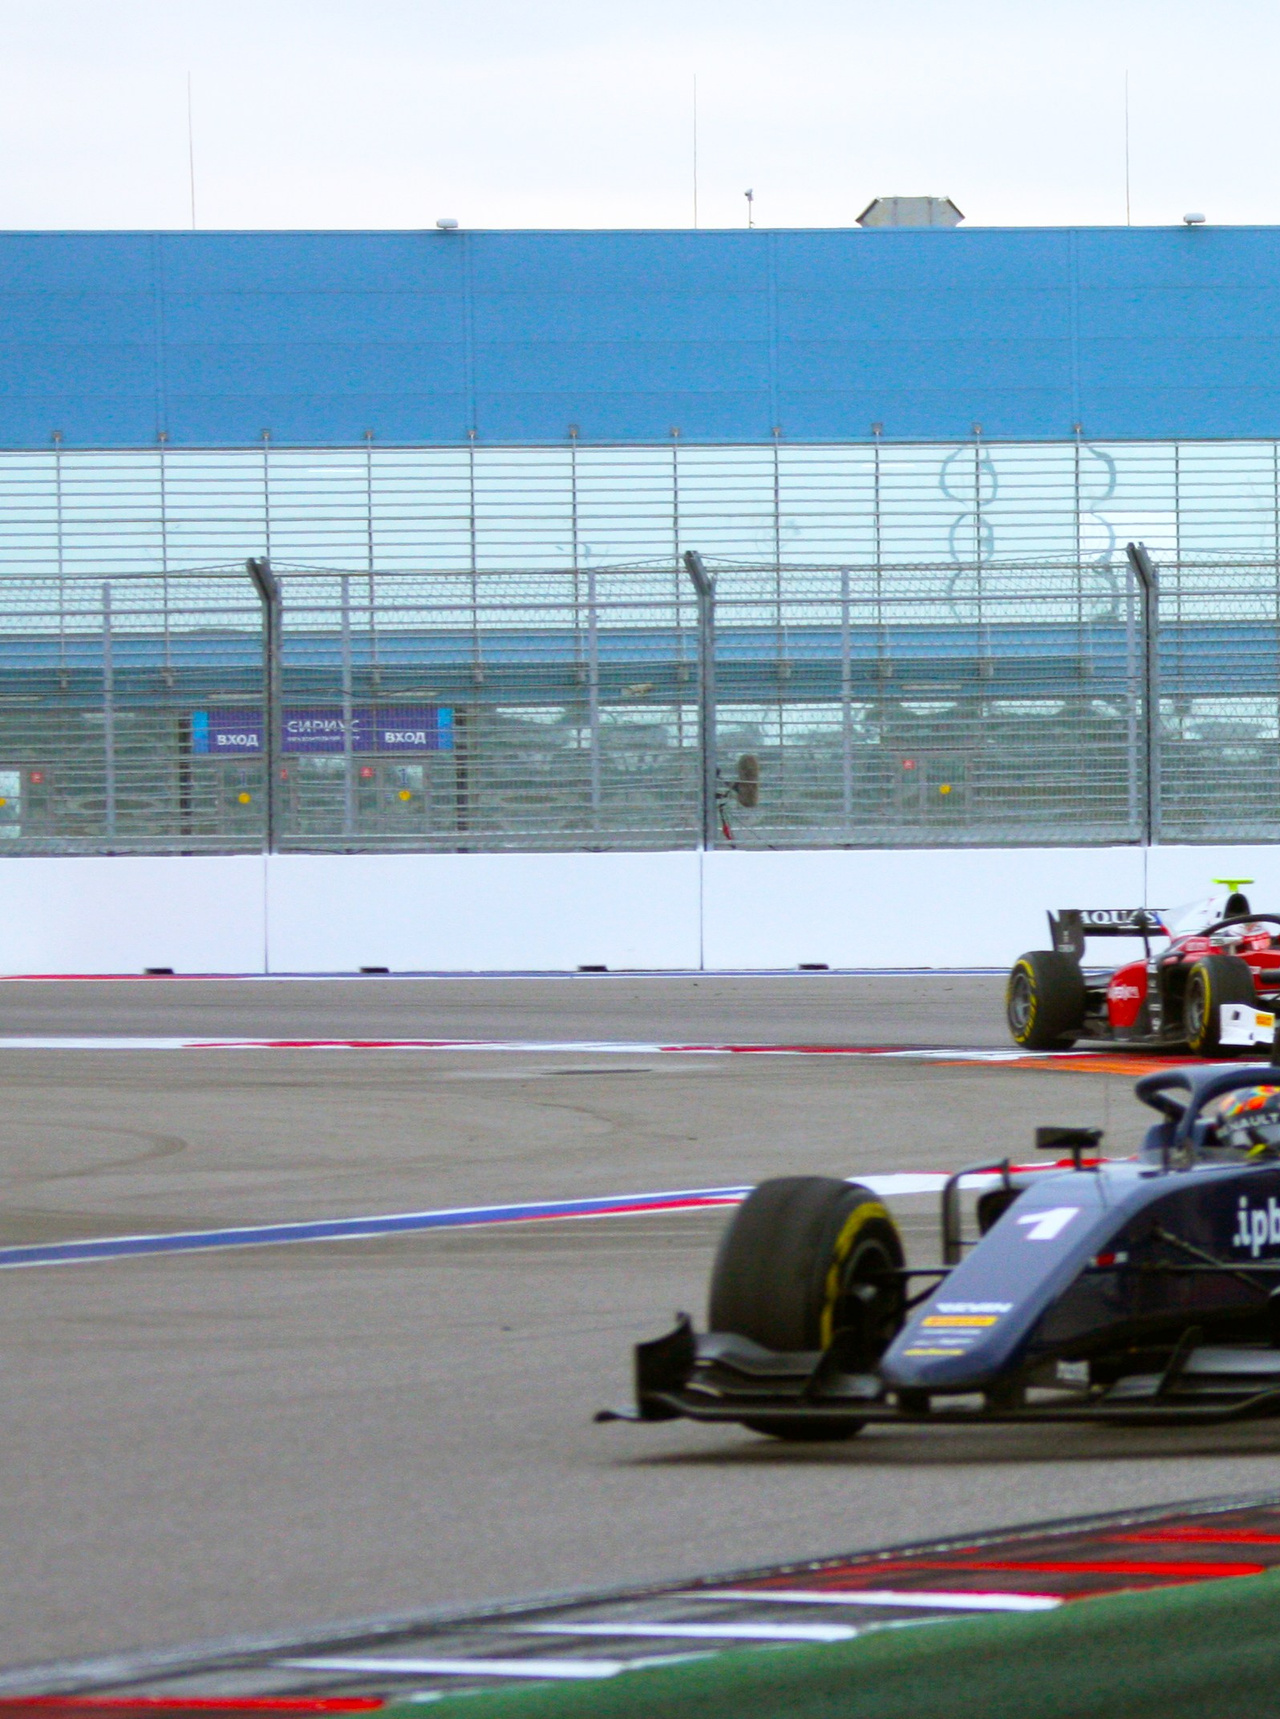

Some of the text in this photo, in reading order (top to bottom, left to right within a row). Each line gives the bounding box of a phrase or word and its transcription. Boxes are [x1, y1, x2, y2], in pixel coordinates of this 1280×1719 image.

[217, 733, 259, 747] ВХОД
[385, 731, 426, 744] ВХОД
[1016, 1206, 1081, 1241] 1
